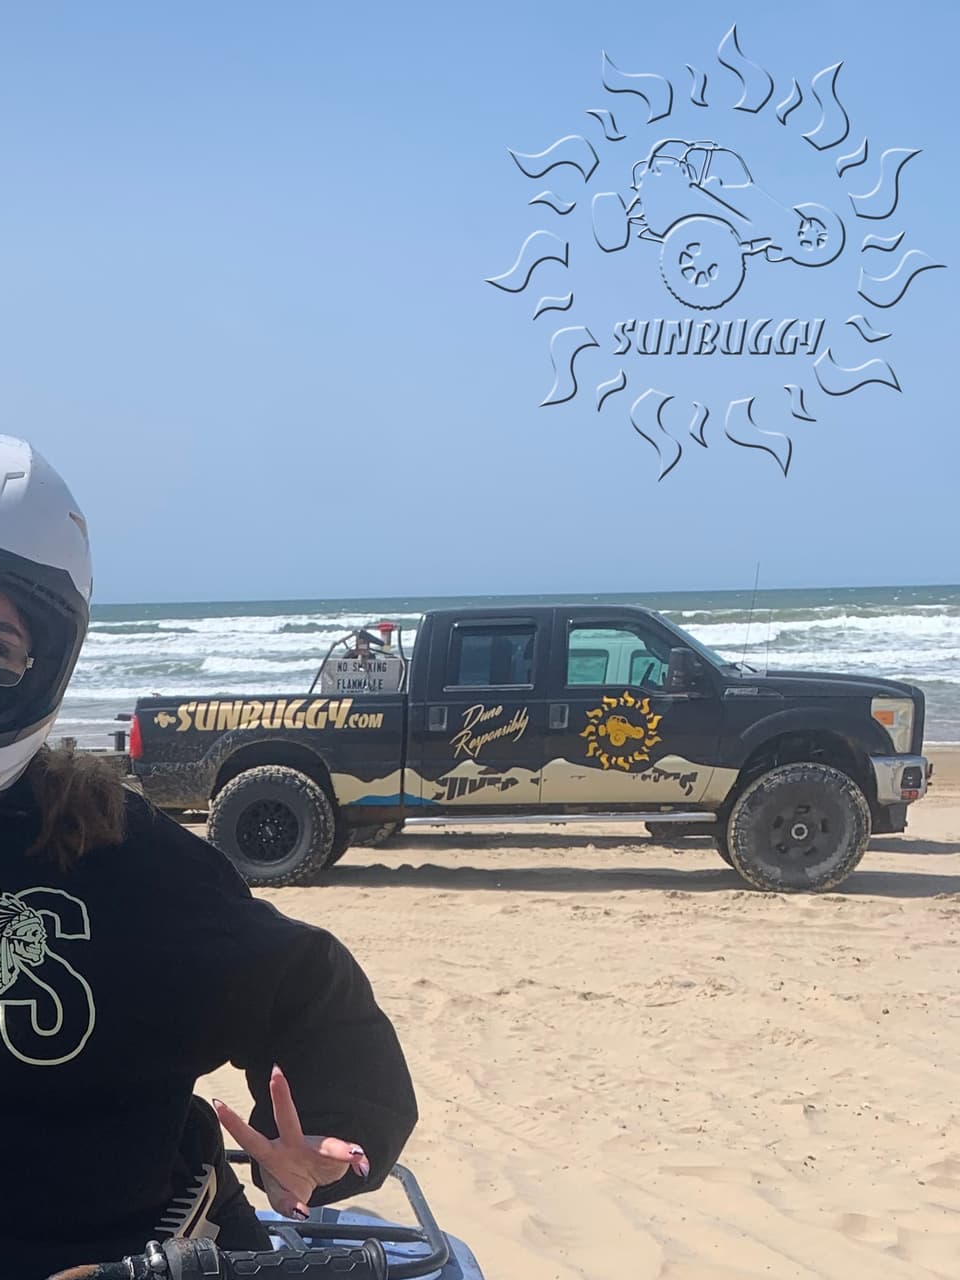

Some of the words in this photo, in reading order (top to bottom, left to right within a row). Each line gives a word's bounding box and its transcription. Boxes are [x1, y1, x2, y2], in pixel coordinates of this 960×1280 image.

[337, 662, 348, 672] NO
[462, 704, 503, 730] Dune
[449, 706, 529, 758] Responsibly
